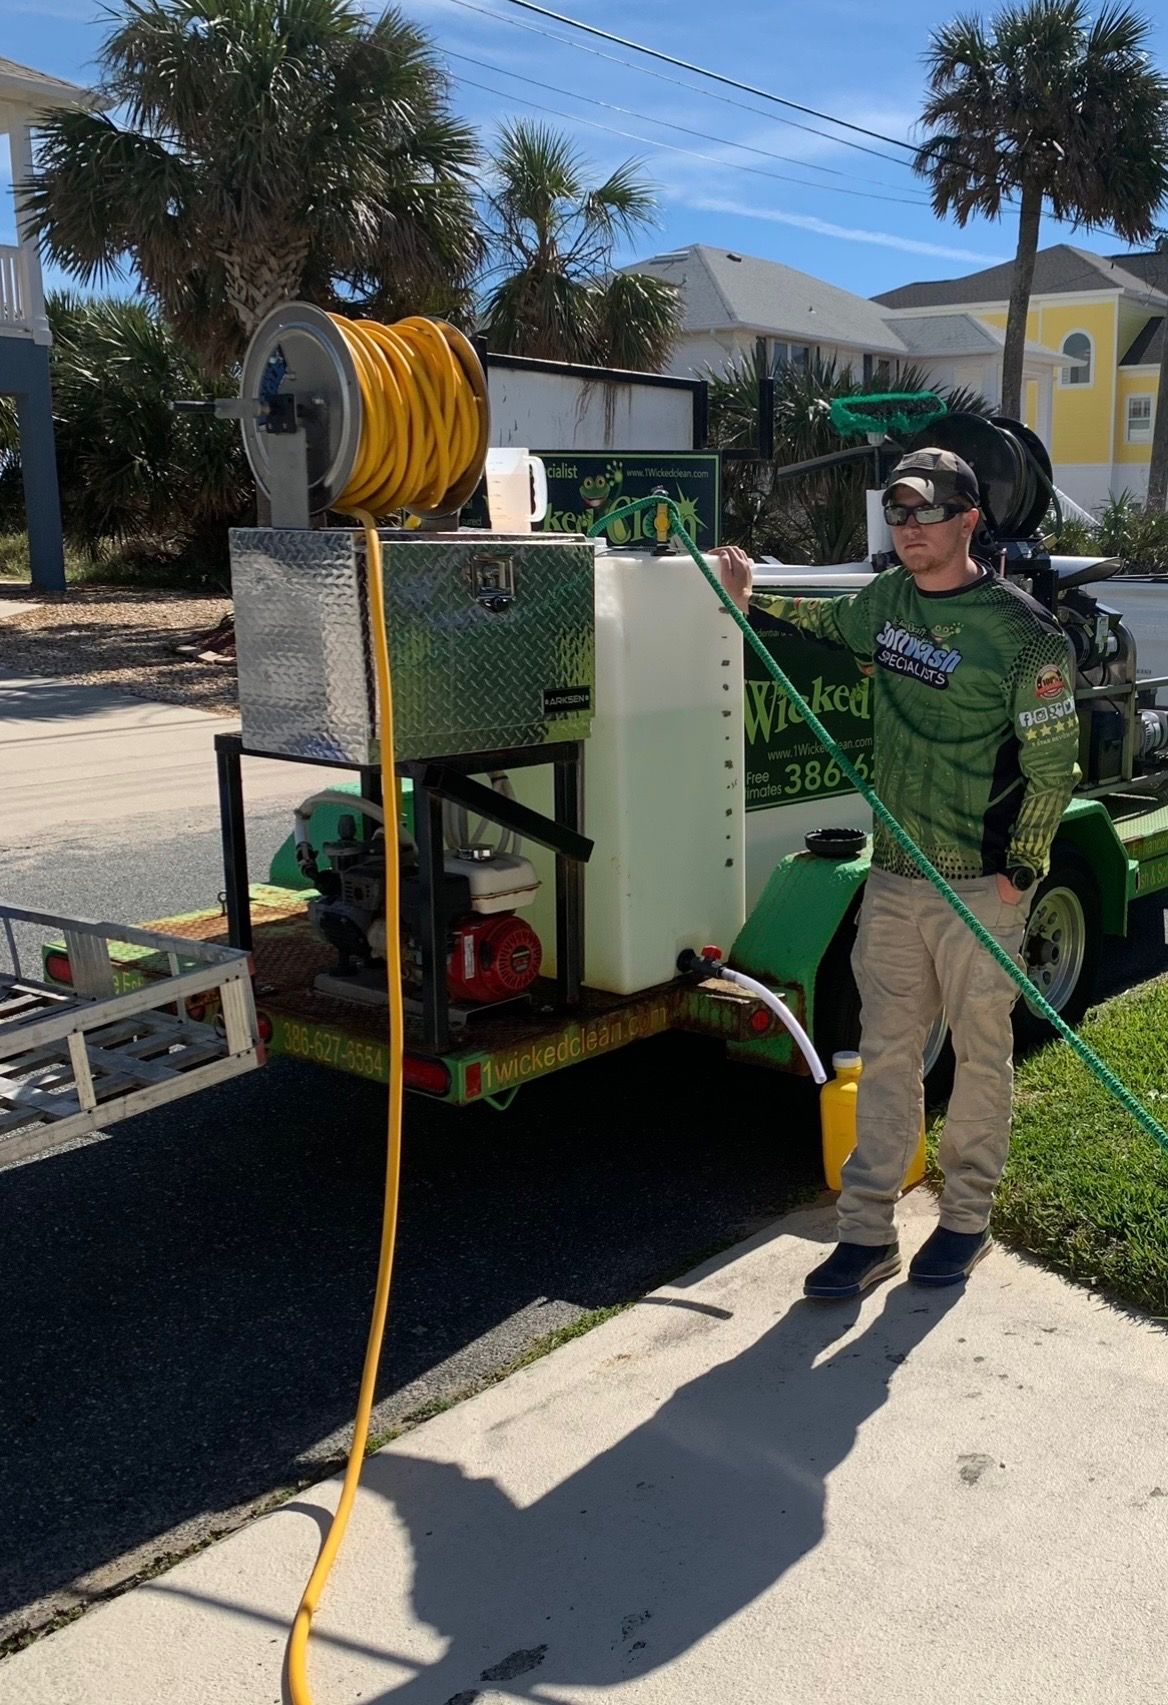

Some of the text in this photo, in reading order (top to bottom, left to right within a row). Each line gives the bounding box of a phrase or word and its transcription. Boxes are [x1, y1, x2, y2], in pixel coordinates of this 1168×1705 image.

[547, 462, 578, 479] cialist
[626, 467, 709, 479] www.1Wickedclean.com
[878, 650, 946, 685] SPECIALISTS
[747, 771, 770, 785] Free
[746, 784, 783, 800] imates
[283, 1022, 383, 1078] 386-627-6554
[482, 1006, 667, 1088] 1wickedclean.com
